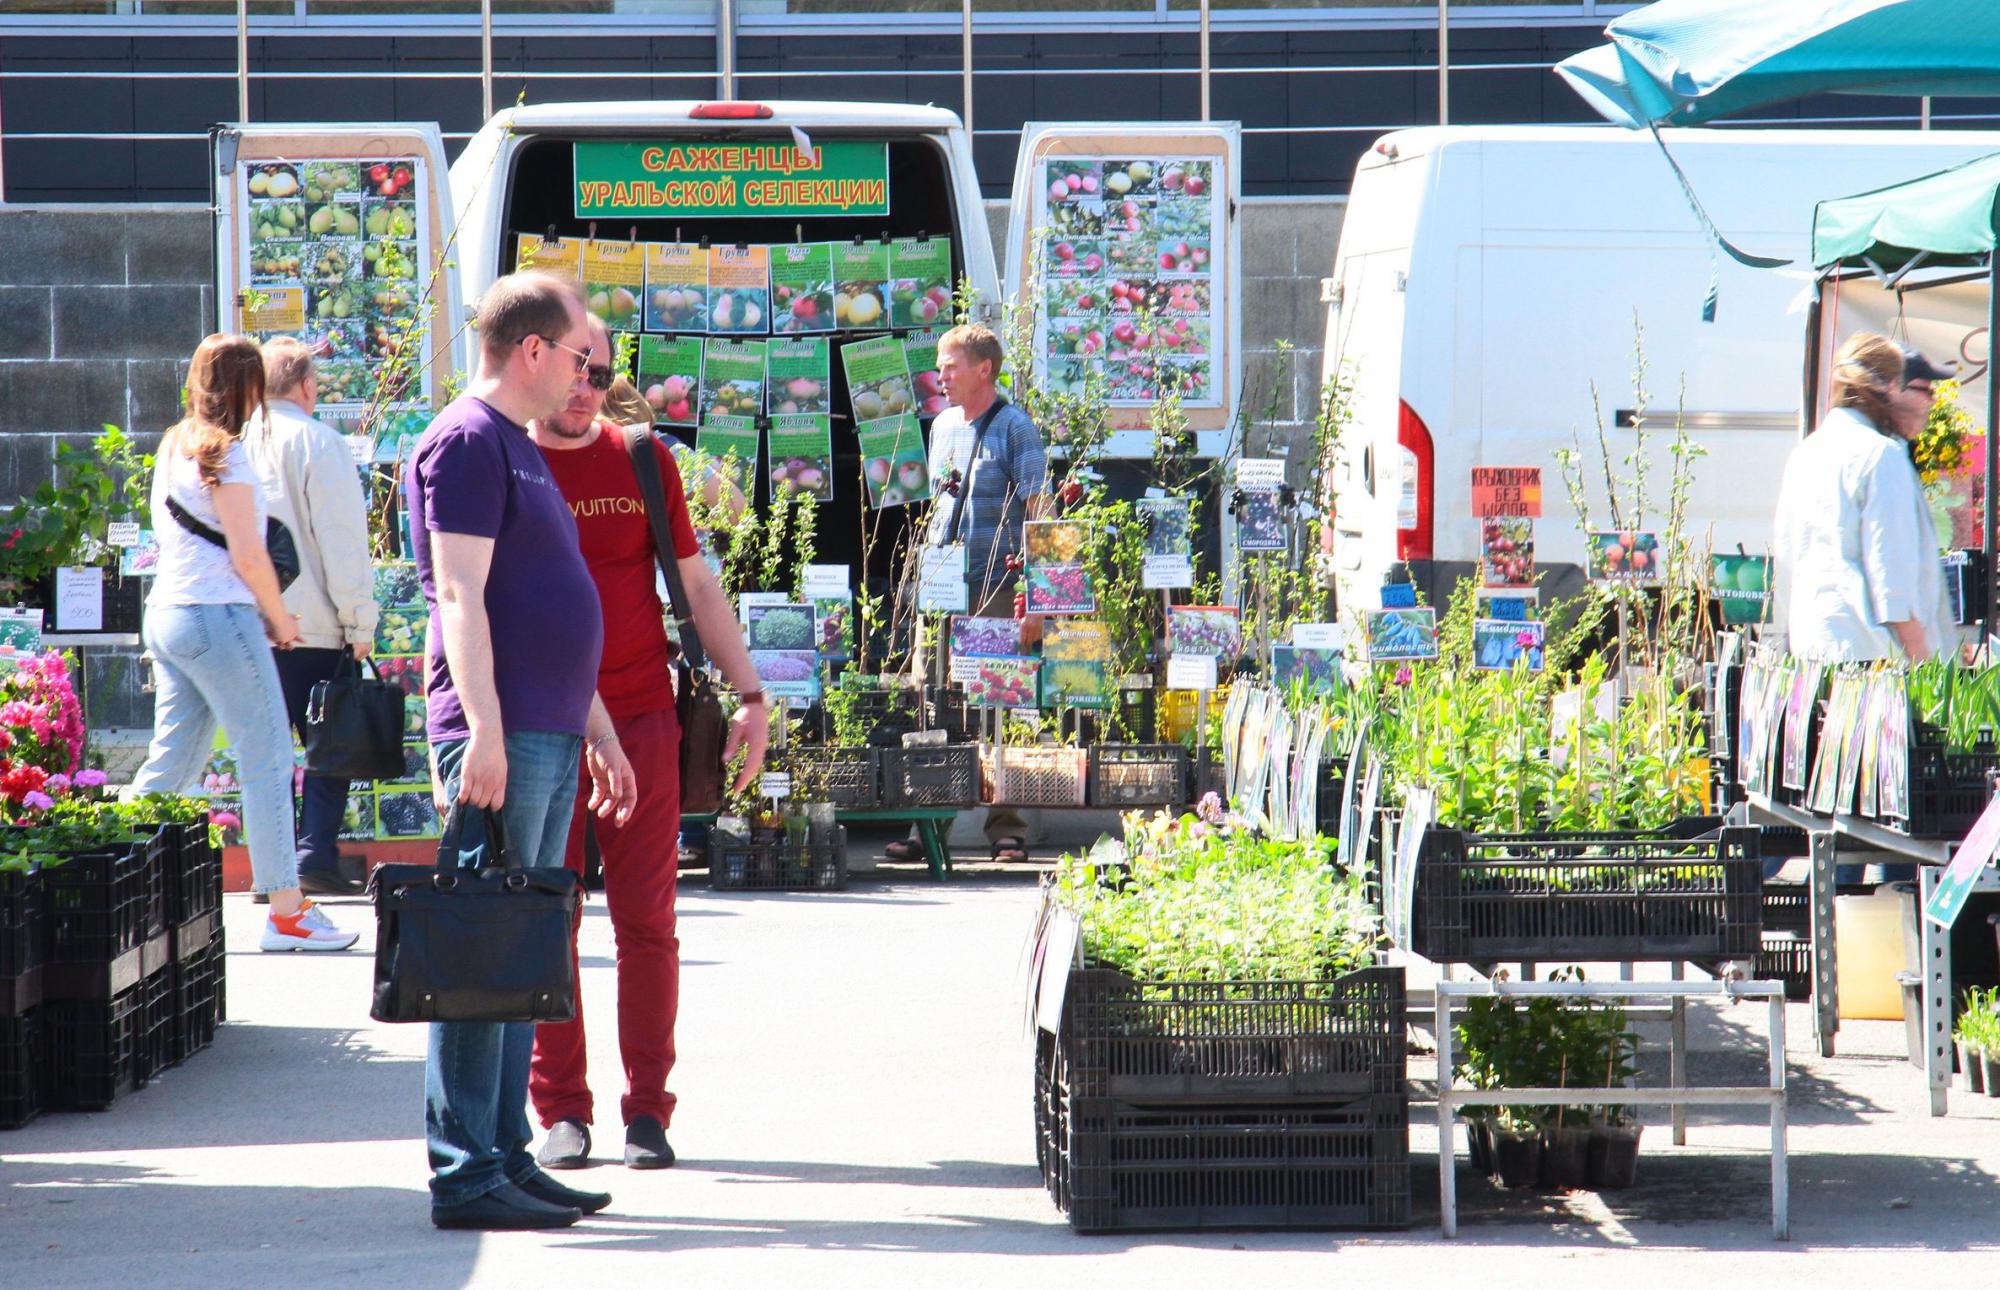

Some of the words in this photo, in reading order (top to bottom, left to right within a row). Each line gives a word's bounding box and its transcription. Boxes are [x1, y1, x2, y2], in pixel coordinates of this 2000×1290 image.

[642, 146, 822, 176] САЖЕНЦЫ
[579, 175, 736, 208] УРАЛЬСКОЙ
[743, 179, 885, 211] СЕЛЕКЦИИ
[597, 240, 629, 254] Груша
[659, 244, 691, 257] Груша
[719, 247, 750, 259] Груша
[901, 241, 936, 252] Яблоня
[713, 341, 750, 353] Яблоня
[780, 340, 816, 351] Яблоня
[709, 415, 745, 428] Яблоня
[780, 414, 816, 427] Яблоня
[1495, 487, 1521, 502] БЕЗ
[567, 496, 645, 518] VUITTON
[1482, 502, 1528, 517] ШИПОВ
